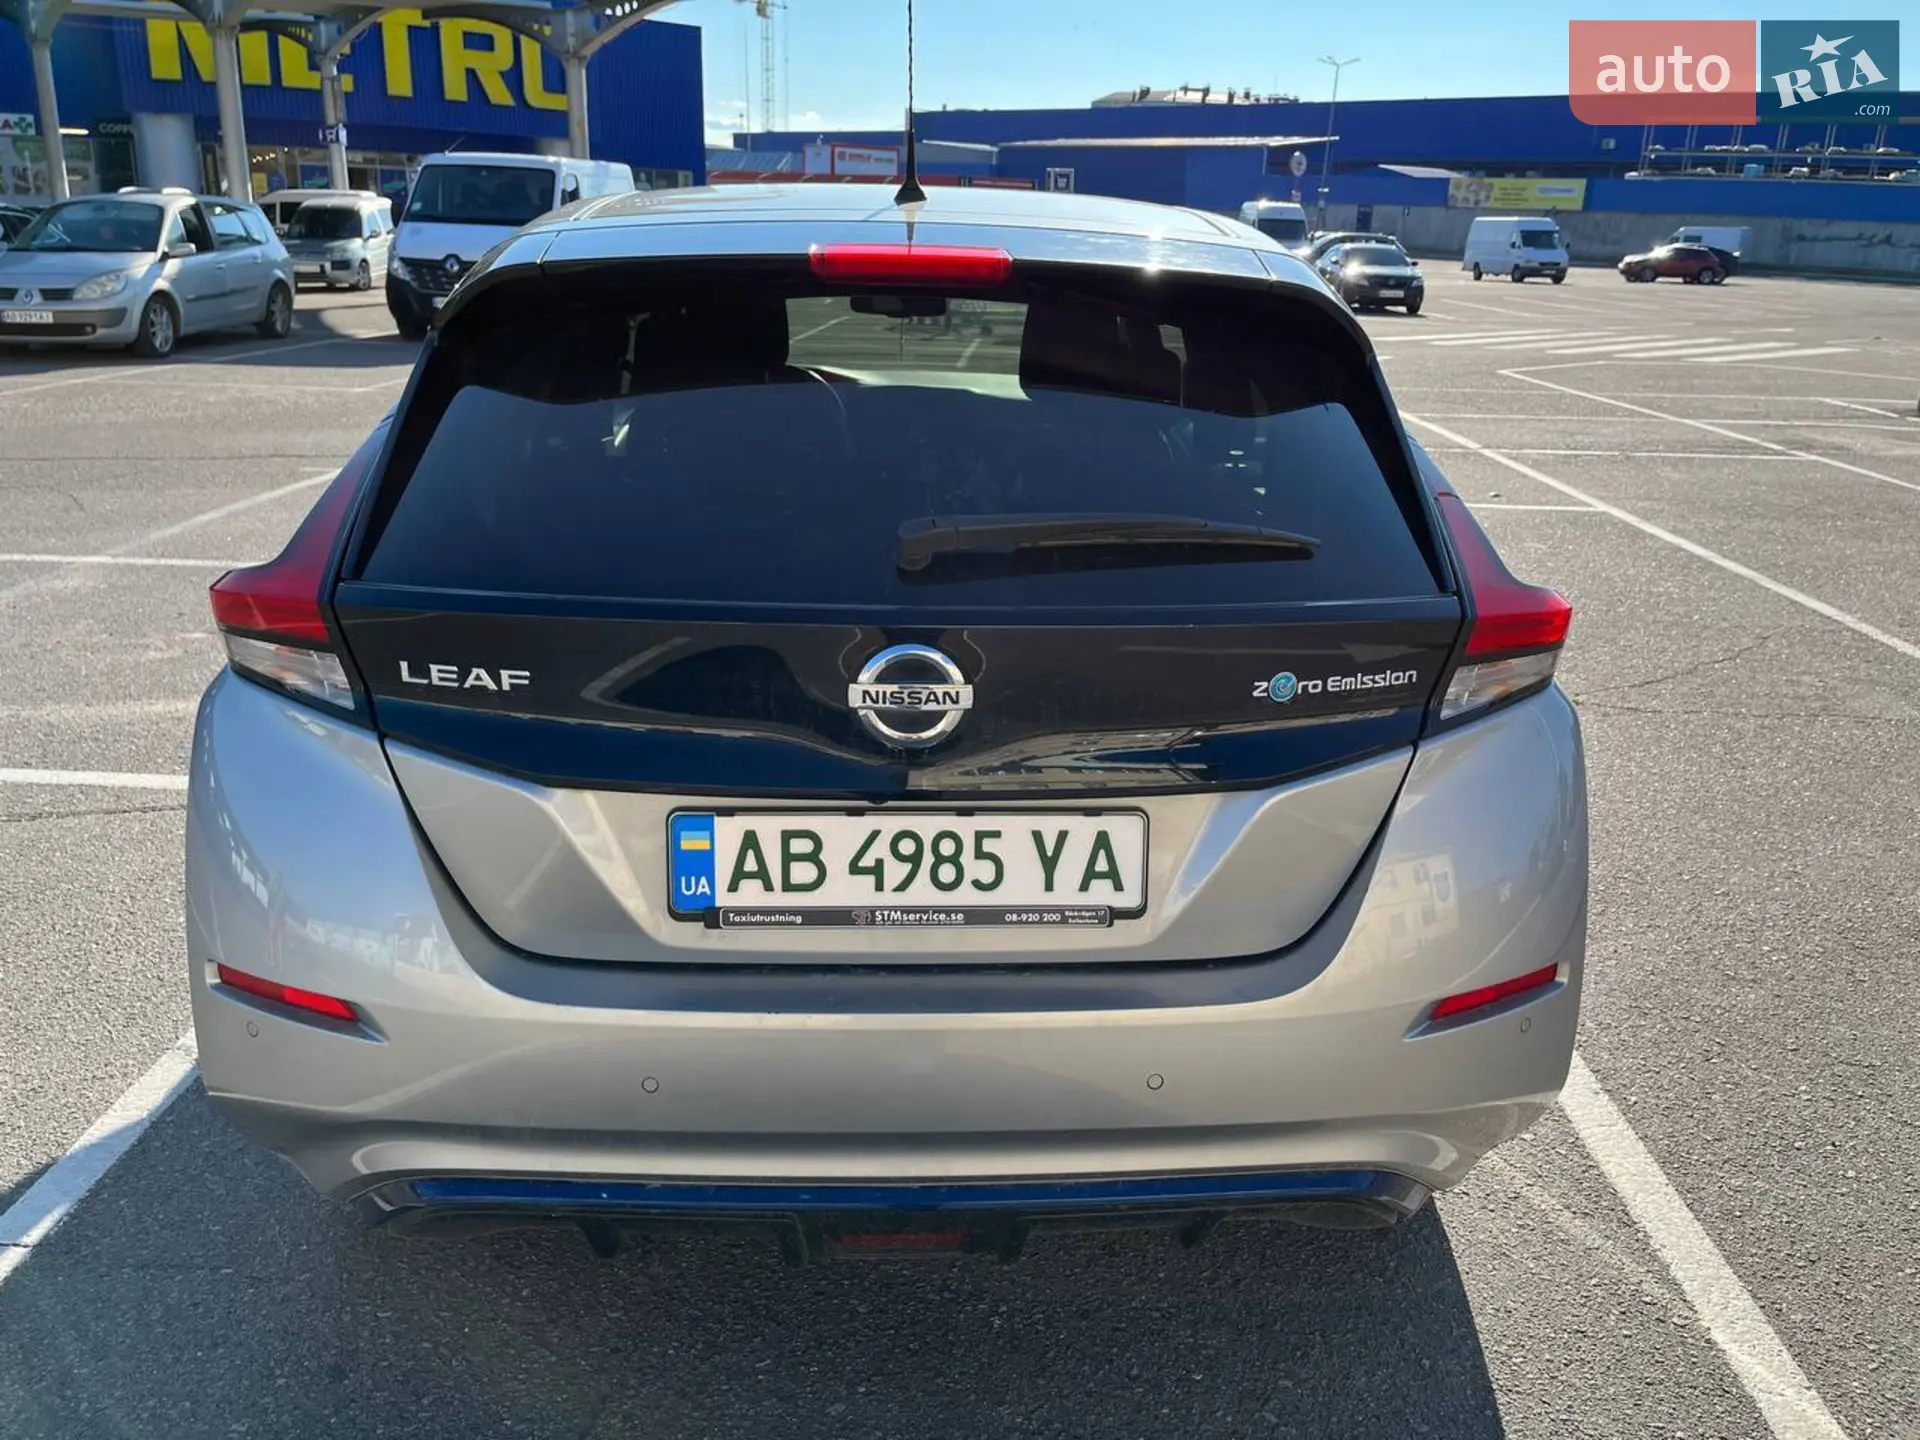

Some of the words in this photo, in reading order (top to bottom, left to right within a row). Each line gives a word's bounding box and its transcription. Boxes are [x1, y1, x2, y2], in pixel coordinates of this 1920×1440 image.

[399, 660, 531, 692] LEAF
[1327, 670, 1417, 692] Emission
[862, 690, 960, 706] NISSAN
[726, 829, 828, 893] AB
[848, 829, 1005, 893] 4985
[1031, 829, 1125, 893] YA
[681, 876, 711, 896] UA
[728, 913, 803, 924] Taxiutrustning
[875, 910, 964, 921] STMservice.se
[1004, 912, 1040, 923] 08-920
[1042, 912, 1062, 923] 200
